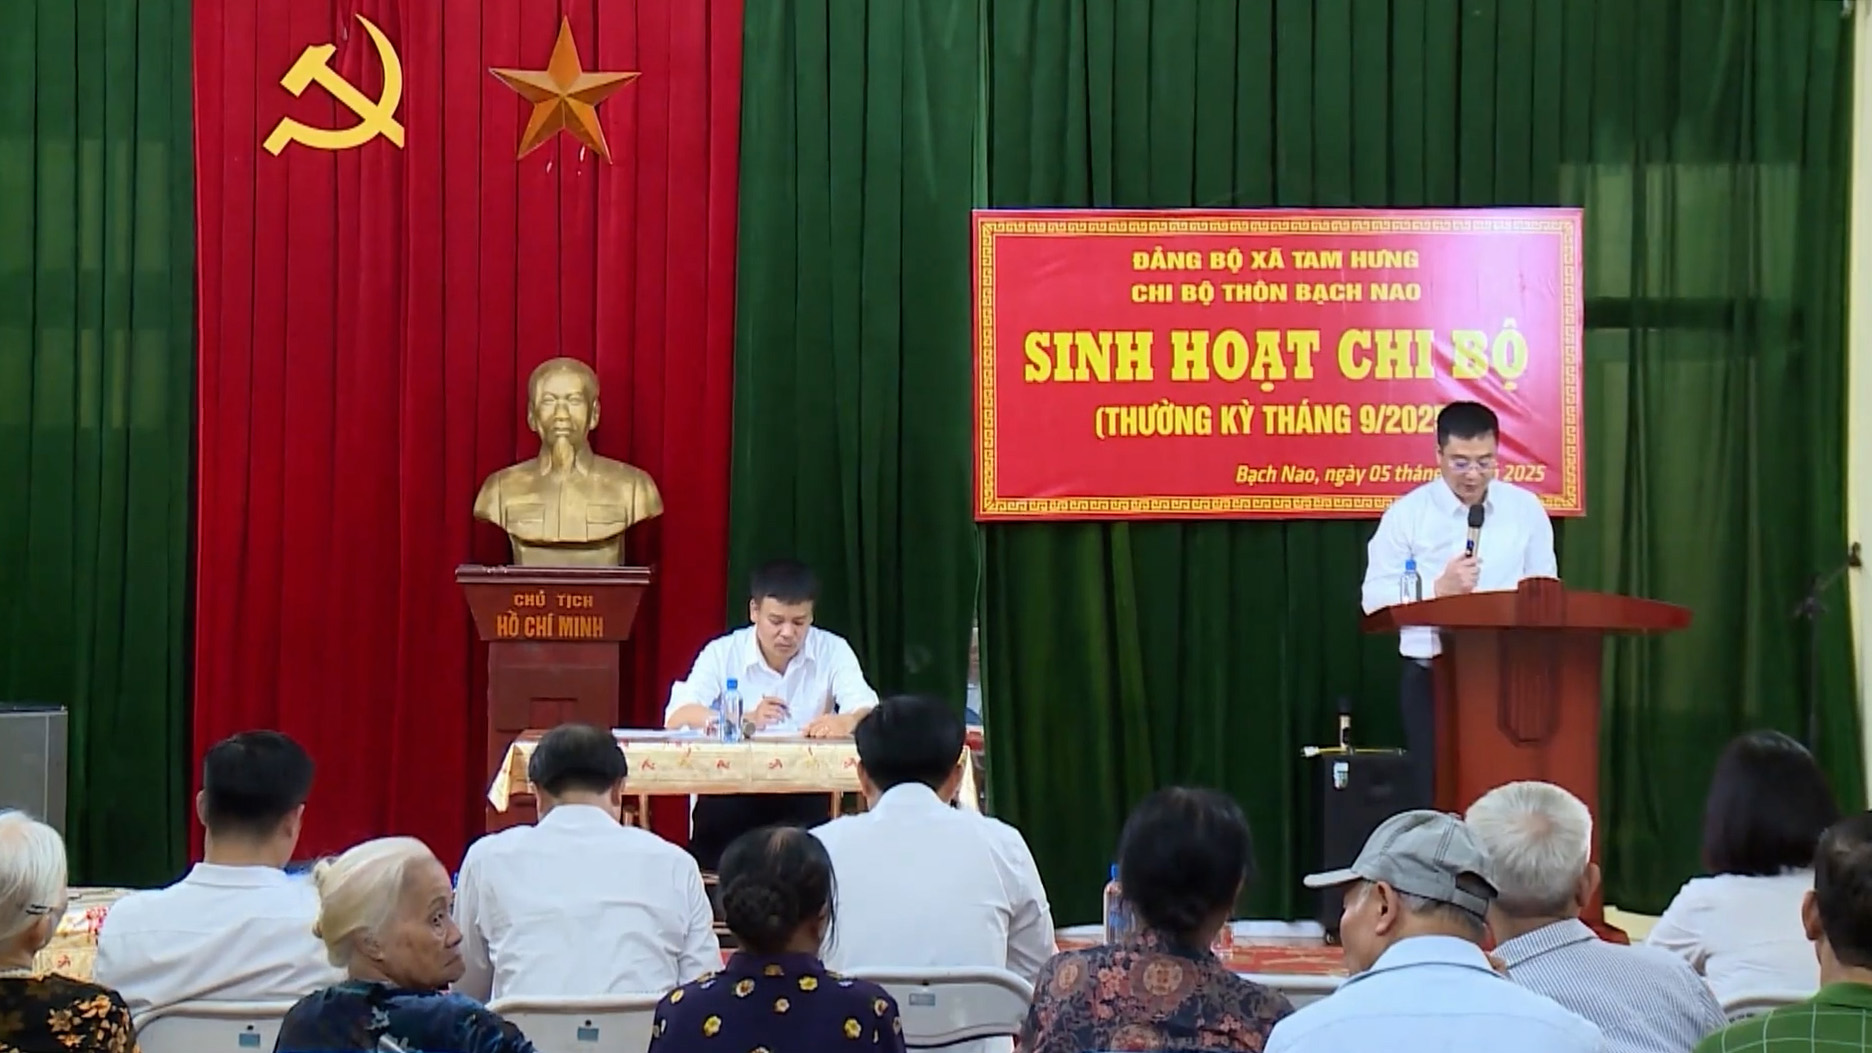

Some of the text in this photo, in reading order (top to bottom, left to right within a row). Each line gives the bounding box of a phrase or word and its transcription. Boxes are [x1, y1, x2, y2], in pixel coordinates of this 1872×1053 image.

[1132, 246, 1420, 274] ĐẢNG BỘ XÃ TAM HƯNG
[1131, 280, 1421, 306] CHI BỘ THÔN BẠCH NAO
[1024, 318, 1528, 392] SINH HOẠT CHI BỘ
[1095, 399, 1211, 439] (THƯỜNG
[1221, 400, 1255, 434] KỲ
[1263, 399, 1351, 434] THÁNG
[1236, 464, 1276, 484] Bạch
[1281, 466, 1319, 485] Nao,
[1324, 464, 1365, 486] ngày
[1369, 465, 1391, 481] 05
[1503, 464, 1547, 482] 2025
[514, 590, 546, 607] CHỦ
[497, 609, 603, 637] HỒ CHÍ MINH
